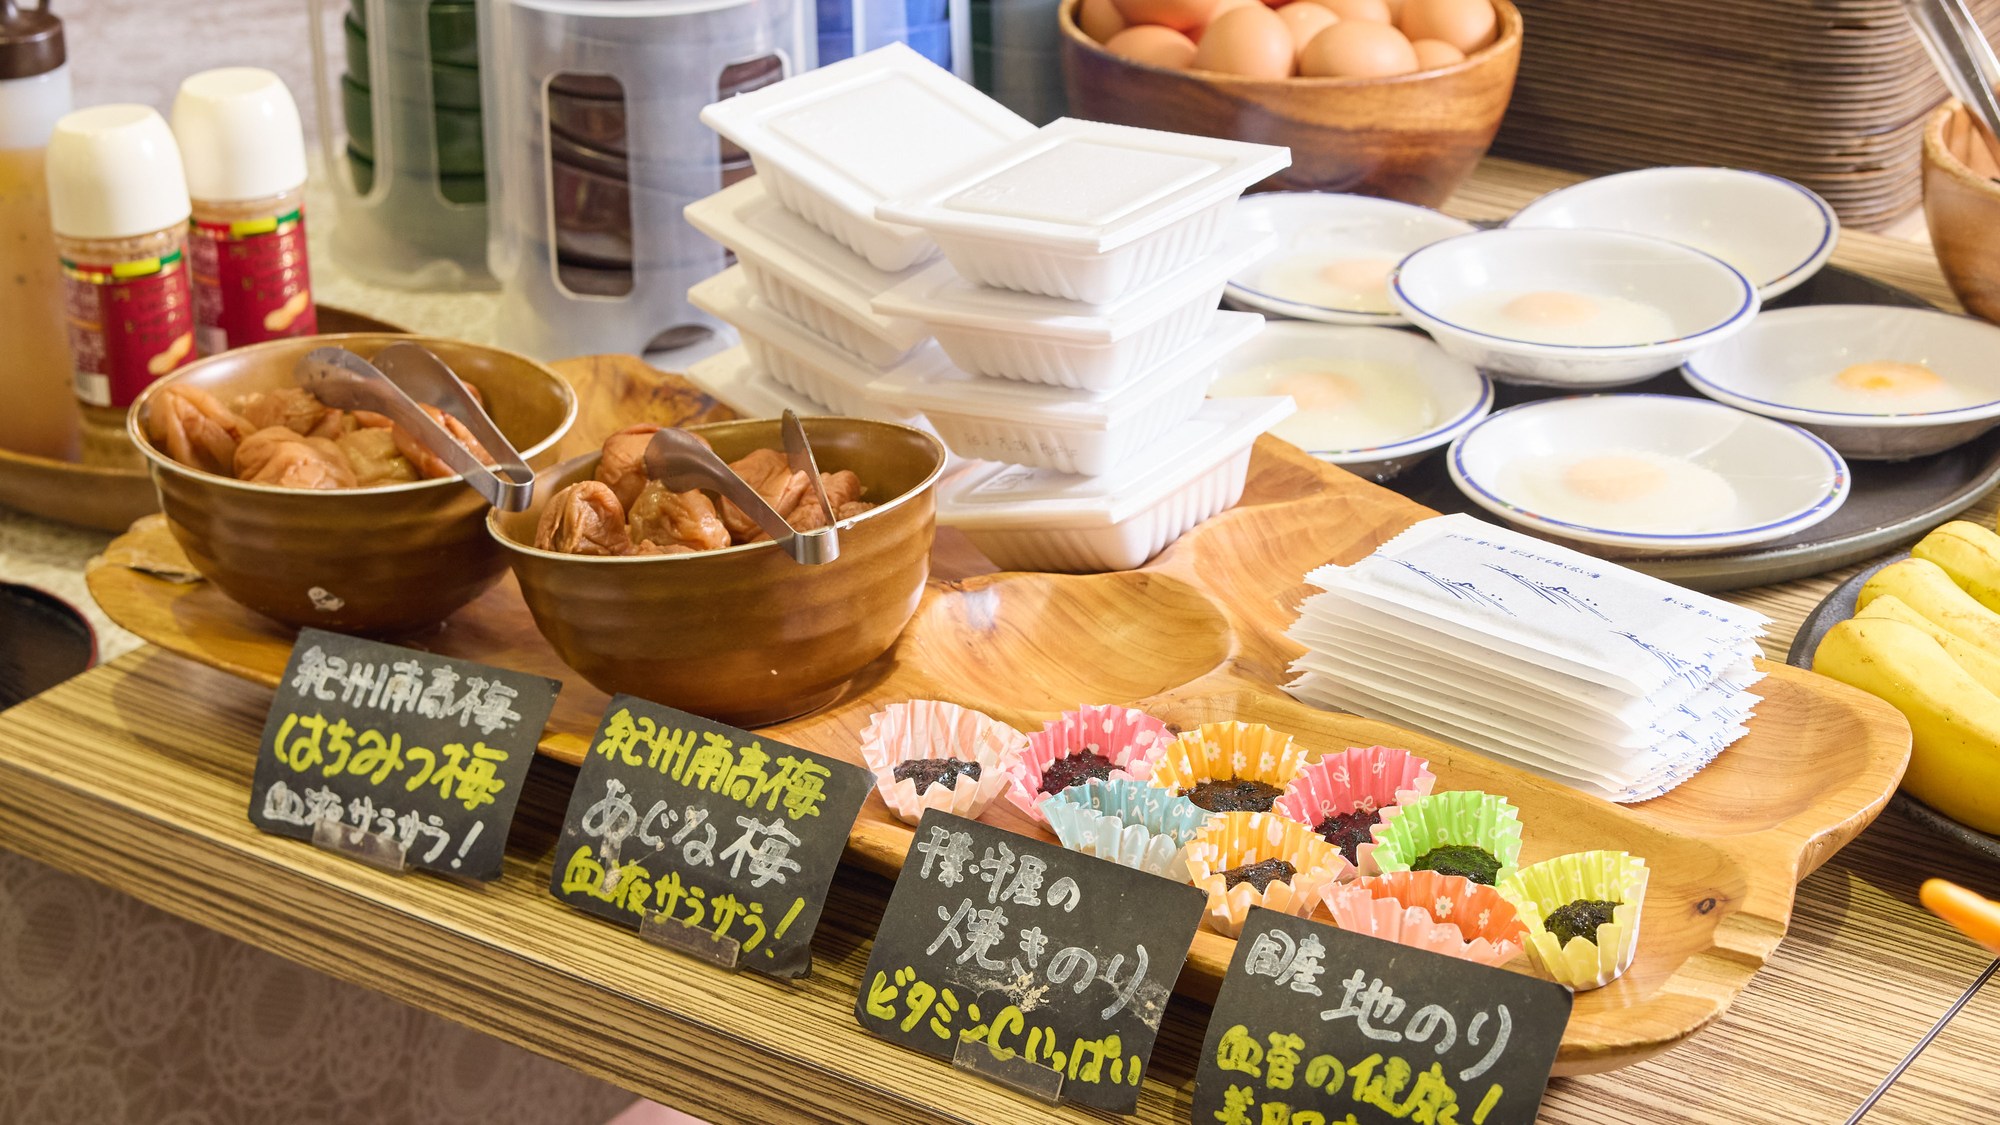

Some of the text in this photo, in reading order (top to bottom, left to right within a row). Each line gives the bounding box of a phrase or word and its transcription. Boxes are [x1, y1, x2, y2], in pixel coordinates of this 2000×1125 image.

[291, 645, 521, 735] 紀州南高梅
[274, 712, 509, 811] はちみつ梅
[596, 707, 831, 820] 紀州南高梅
[926, 898, 1149, 1020] 焼きのり
[1244, 928, 1512, 1082] 国産 地のり
